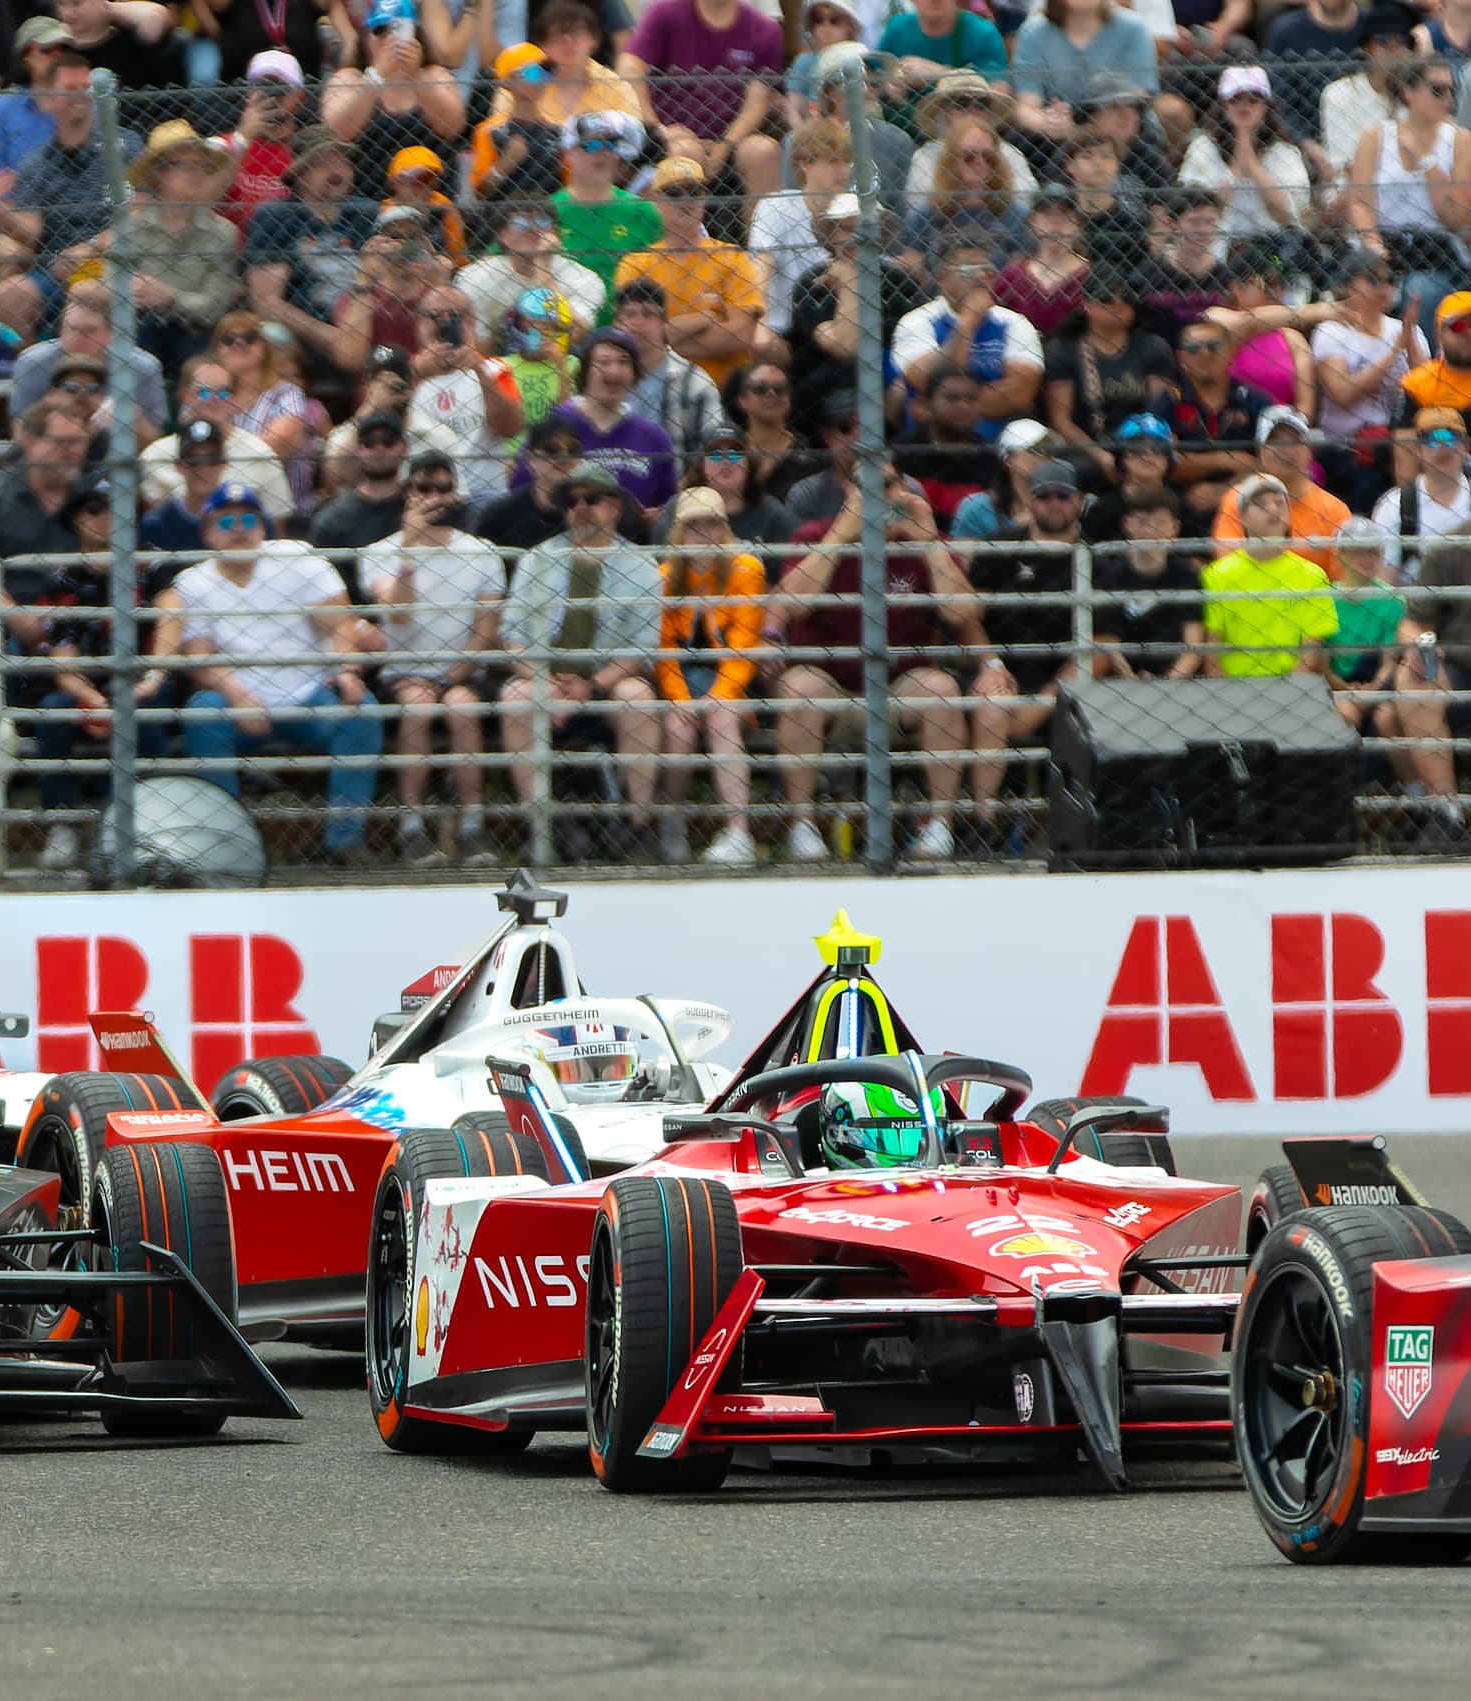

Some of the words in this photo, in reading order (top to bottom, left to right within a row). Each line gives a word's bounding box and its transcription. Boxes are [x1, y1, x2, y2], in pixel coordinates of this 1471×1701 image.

[503, 1009, 600, 1026] GUGGENHEIM
[573, 1043, 627, 1057] ANDRETTI
[890, 1121, 922, 1129] NISS
[223, 1149, 355, 1193] HEIM
[1391, 1333, 1429, 1360] TAG
[1388, 1368, 1429, 1410] HEUER
